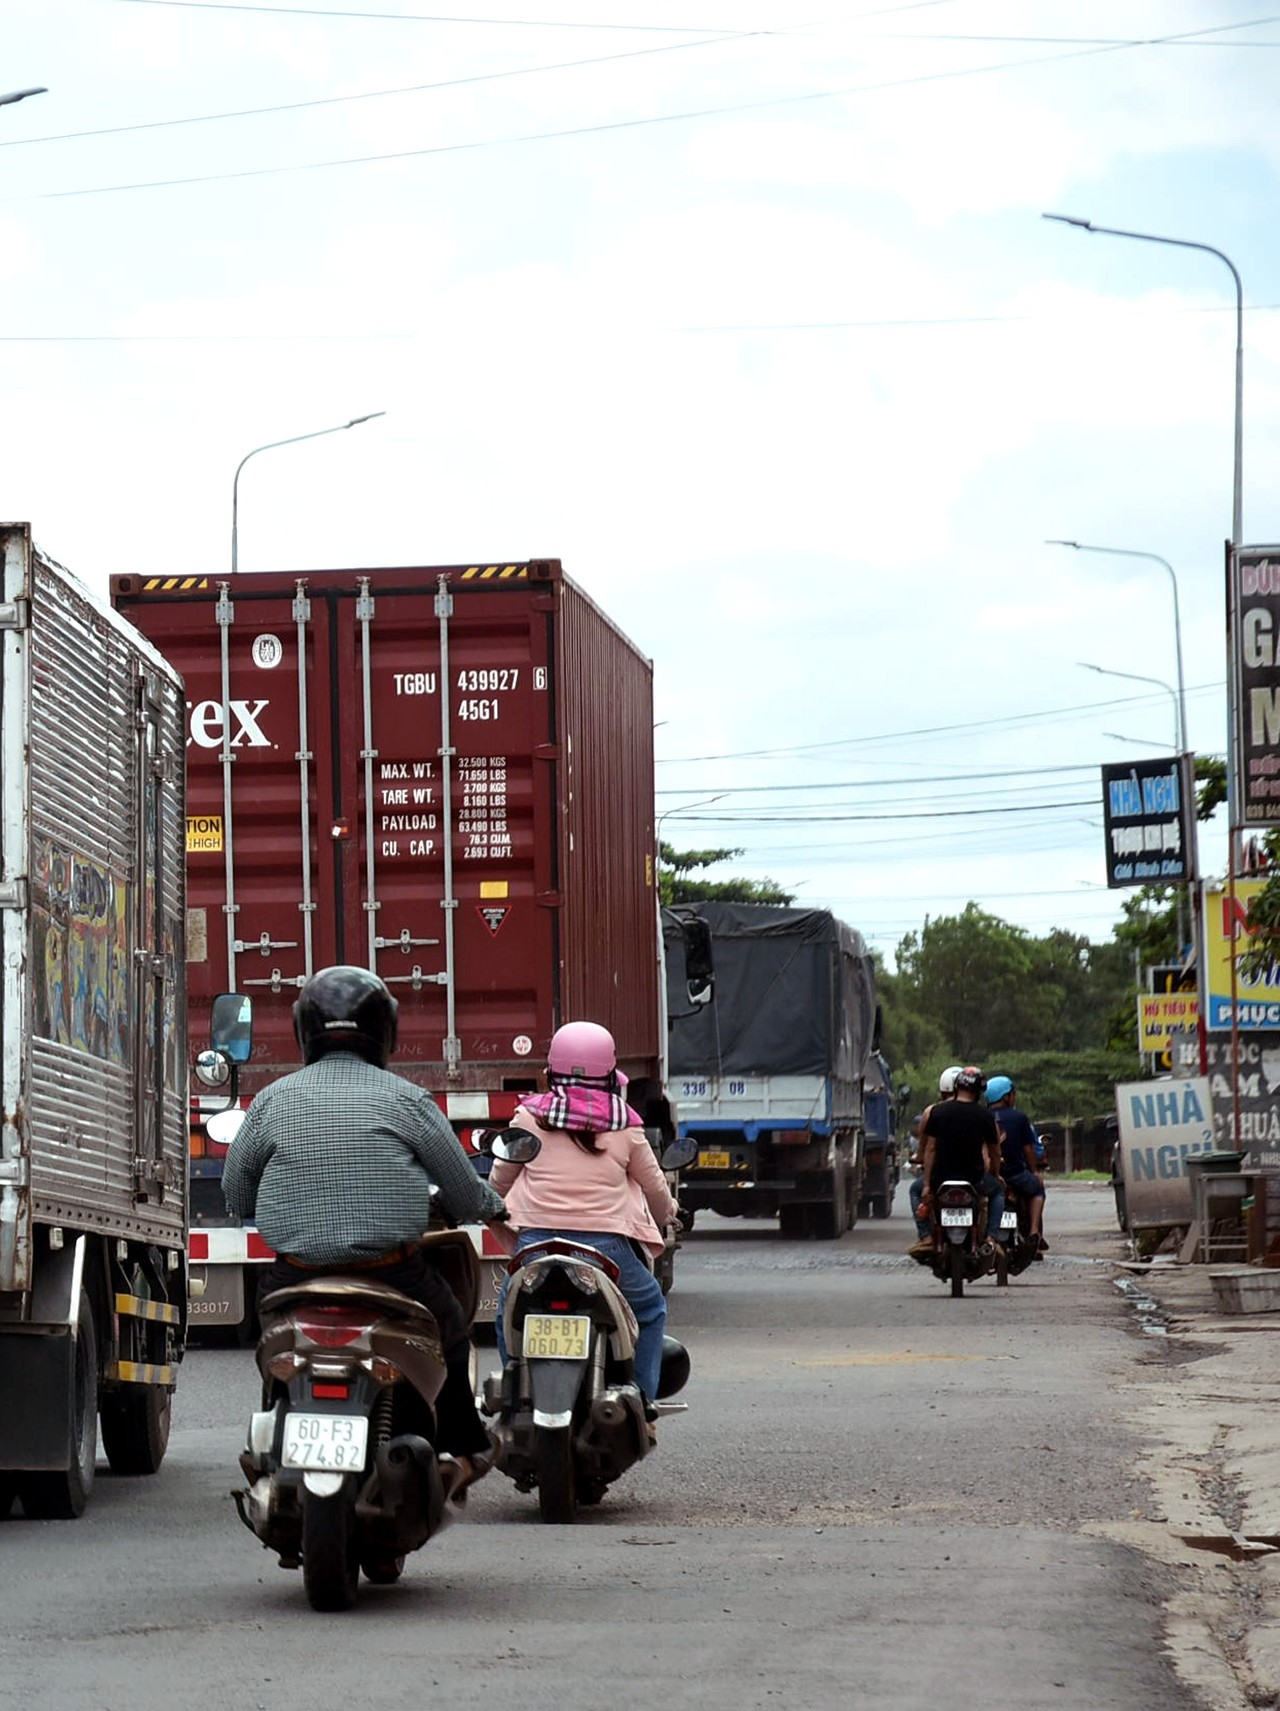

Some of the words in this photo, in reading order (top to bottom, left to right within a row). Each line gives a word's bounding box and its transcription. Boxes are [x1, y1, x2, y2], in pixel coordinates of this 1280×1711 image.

[393, 672, 436, 695] TGBU
[457, 669, 519, 691] 439927
[458, 699, 499, 720] 45G1
[186, 700, 279, 749] ex.
[459, 757, 487, 768] 32.500
[490, 757, 506, 767] KGS
[381, 763, 410, 779] MAX.
[412, 763, 435, 779] WT.
[490, 769, 506, 781] LBS
[464, 783, 487, 793] 3.700
[490, 782, 506, 793] KGS
[381, 789, 408, 805] TARE
[413, 788, 435, 803] WT.
[490, 795, 506, 806] LBS
[490, 808, 506, 819] KGS
[382, 814, 436, 831] PAYLOAD
[490, 821, 506, 832] LBS
[193, 838, 220, 849] HIGH
[382, 841, 400, 856] CU.
[410, 840, 436, 855] CAP.
[682, 1081, 706, 1096] 338
[729, 1081, 745, 1095] 08
[1130, 1082, 1204, 1128] NHÀ
[1130, 1129, 1213, 1182] NGH
[527, 1337, 585, 1357] 060.73
[287, 1442, 360, 1468] 274.82
